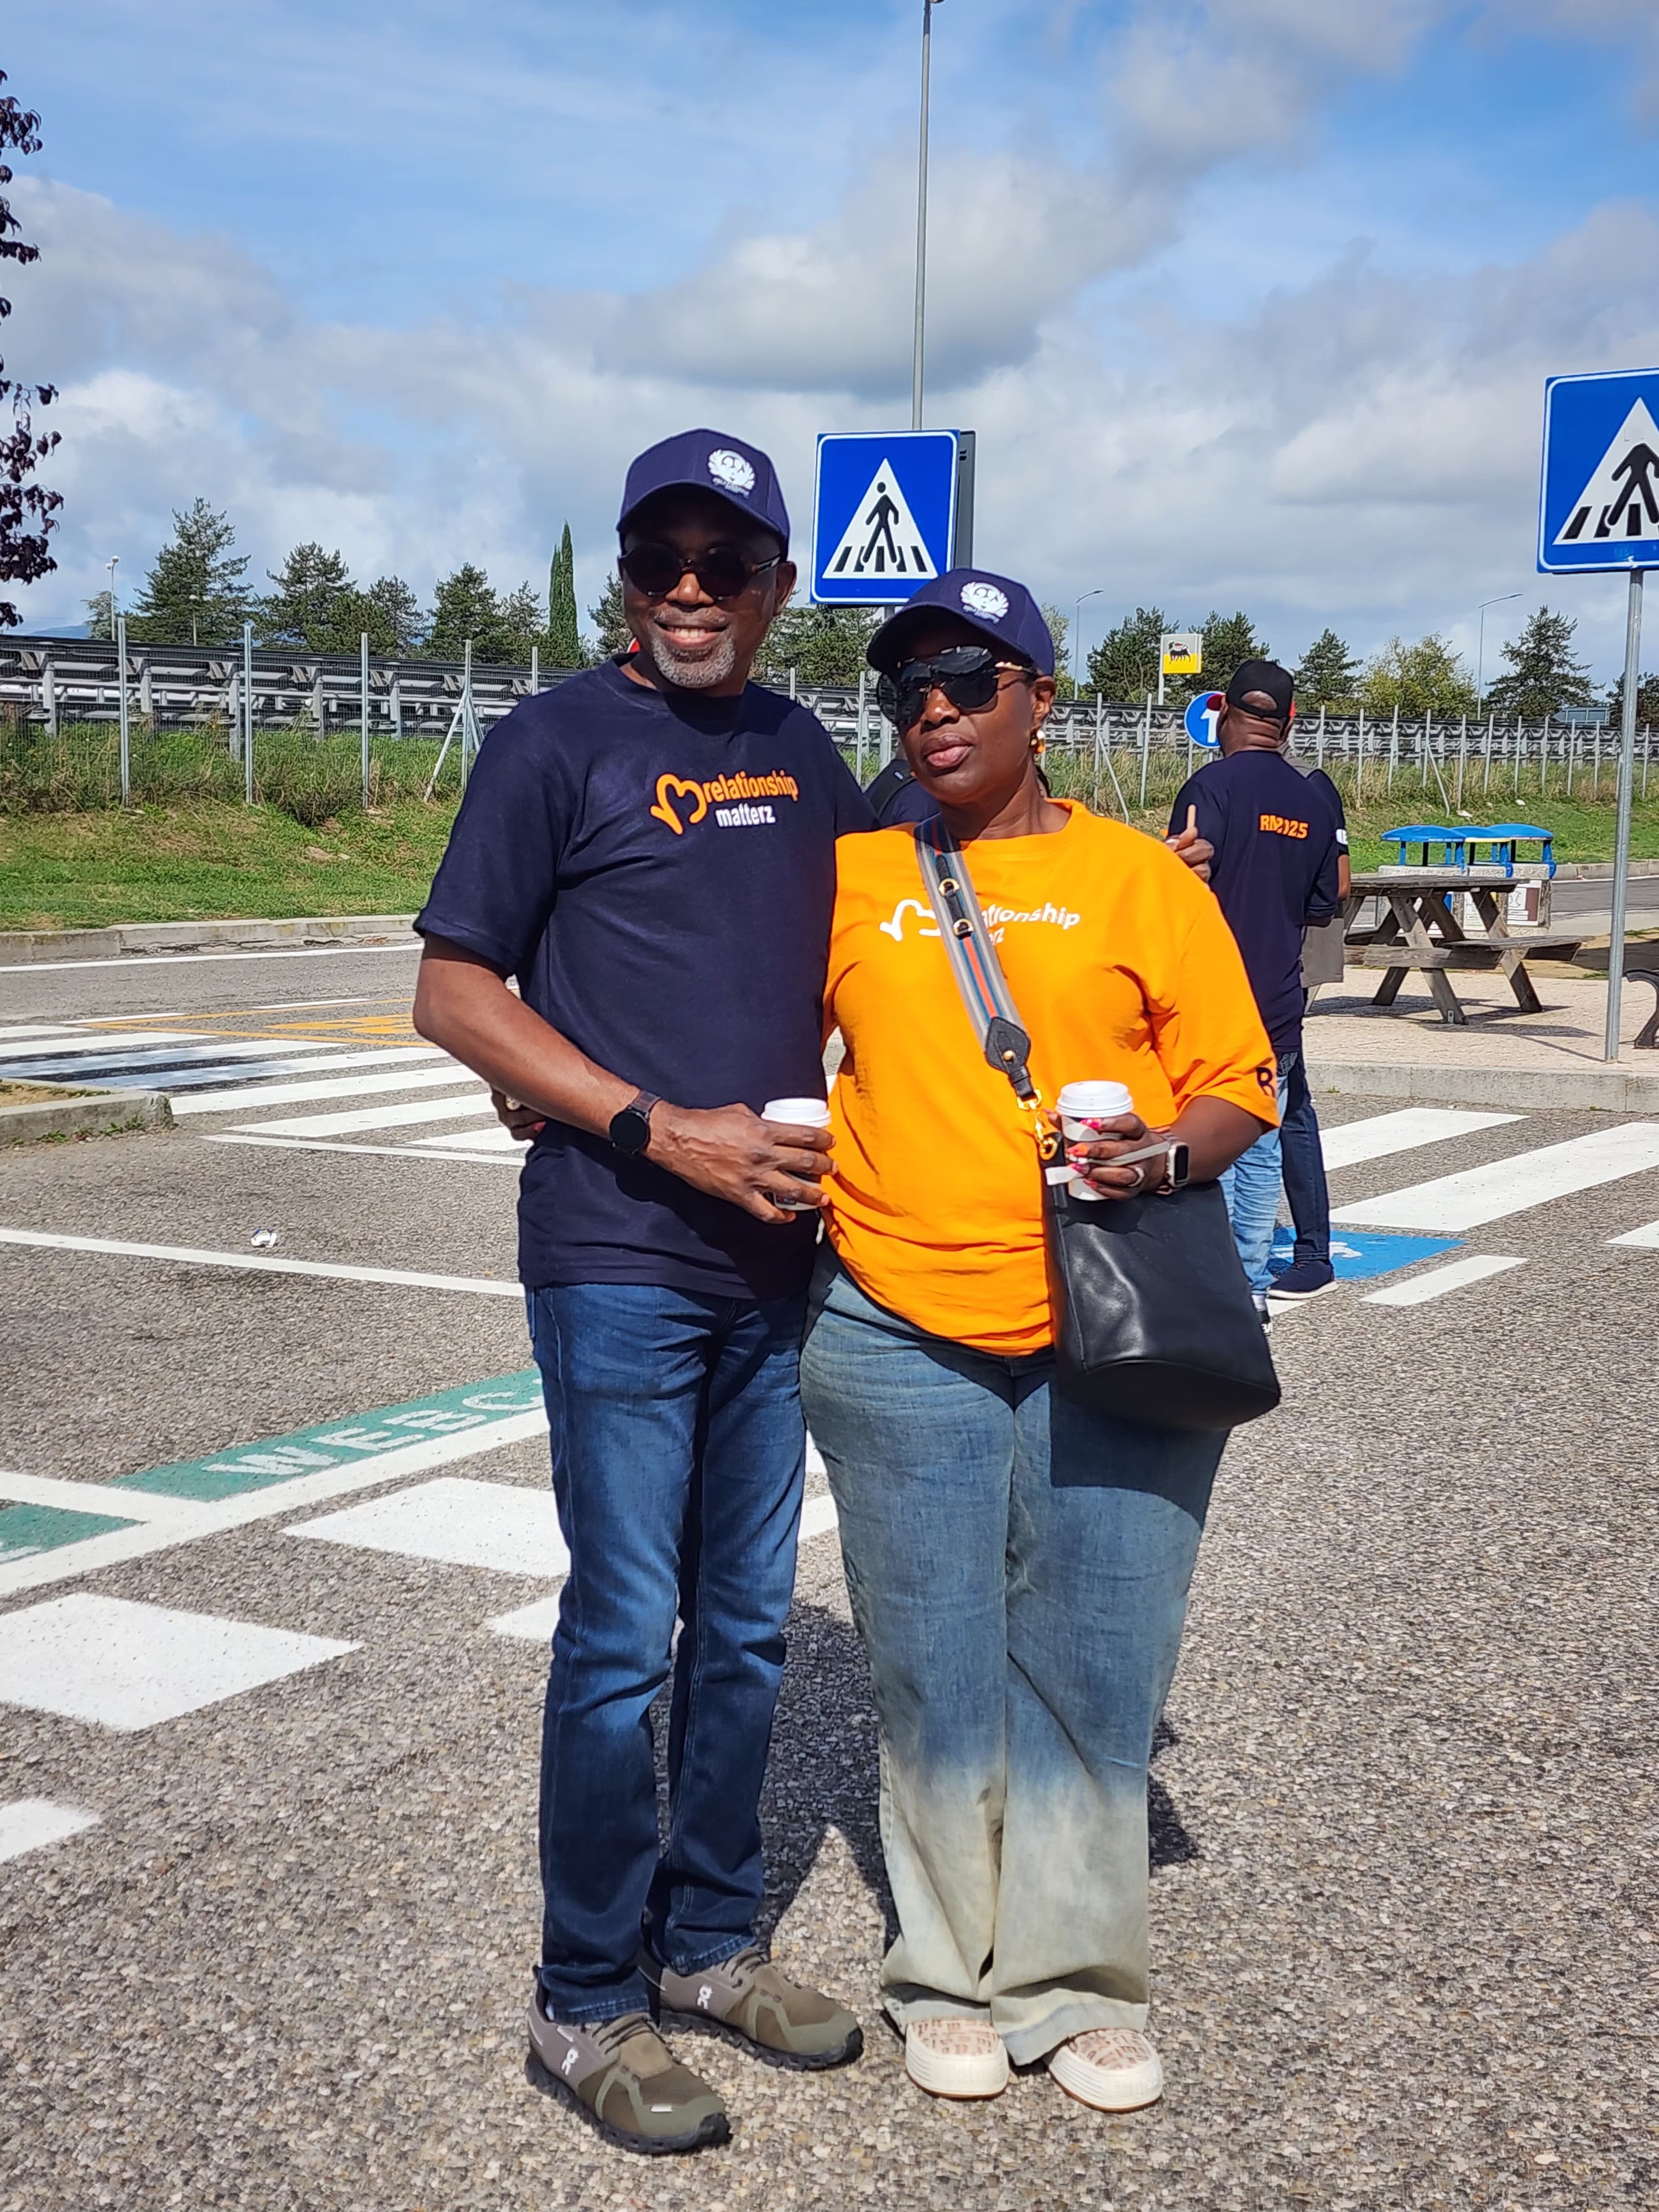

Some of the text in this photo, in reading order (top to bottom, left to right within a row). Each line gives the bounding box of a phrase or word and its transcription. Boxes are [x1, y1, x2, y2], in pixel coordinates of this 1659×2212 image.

[703, 769, 799, 802] relationship
[715, 802, 776, 827] matterz
[981, 902, 1081, 930] ationship
[200, 1378, 544, 1476] WEBC
